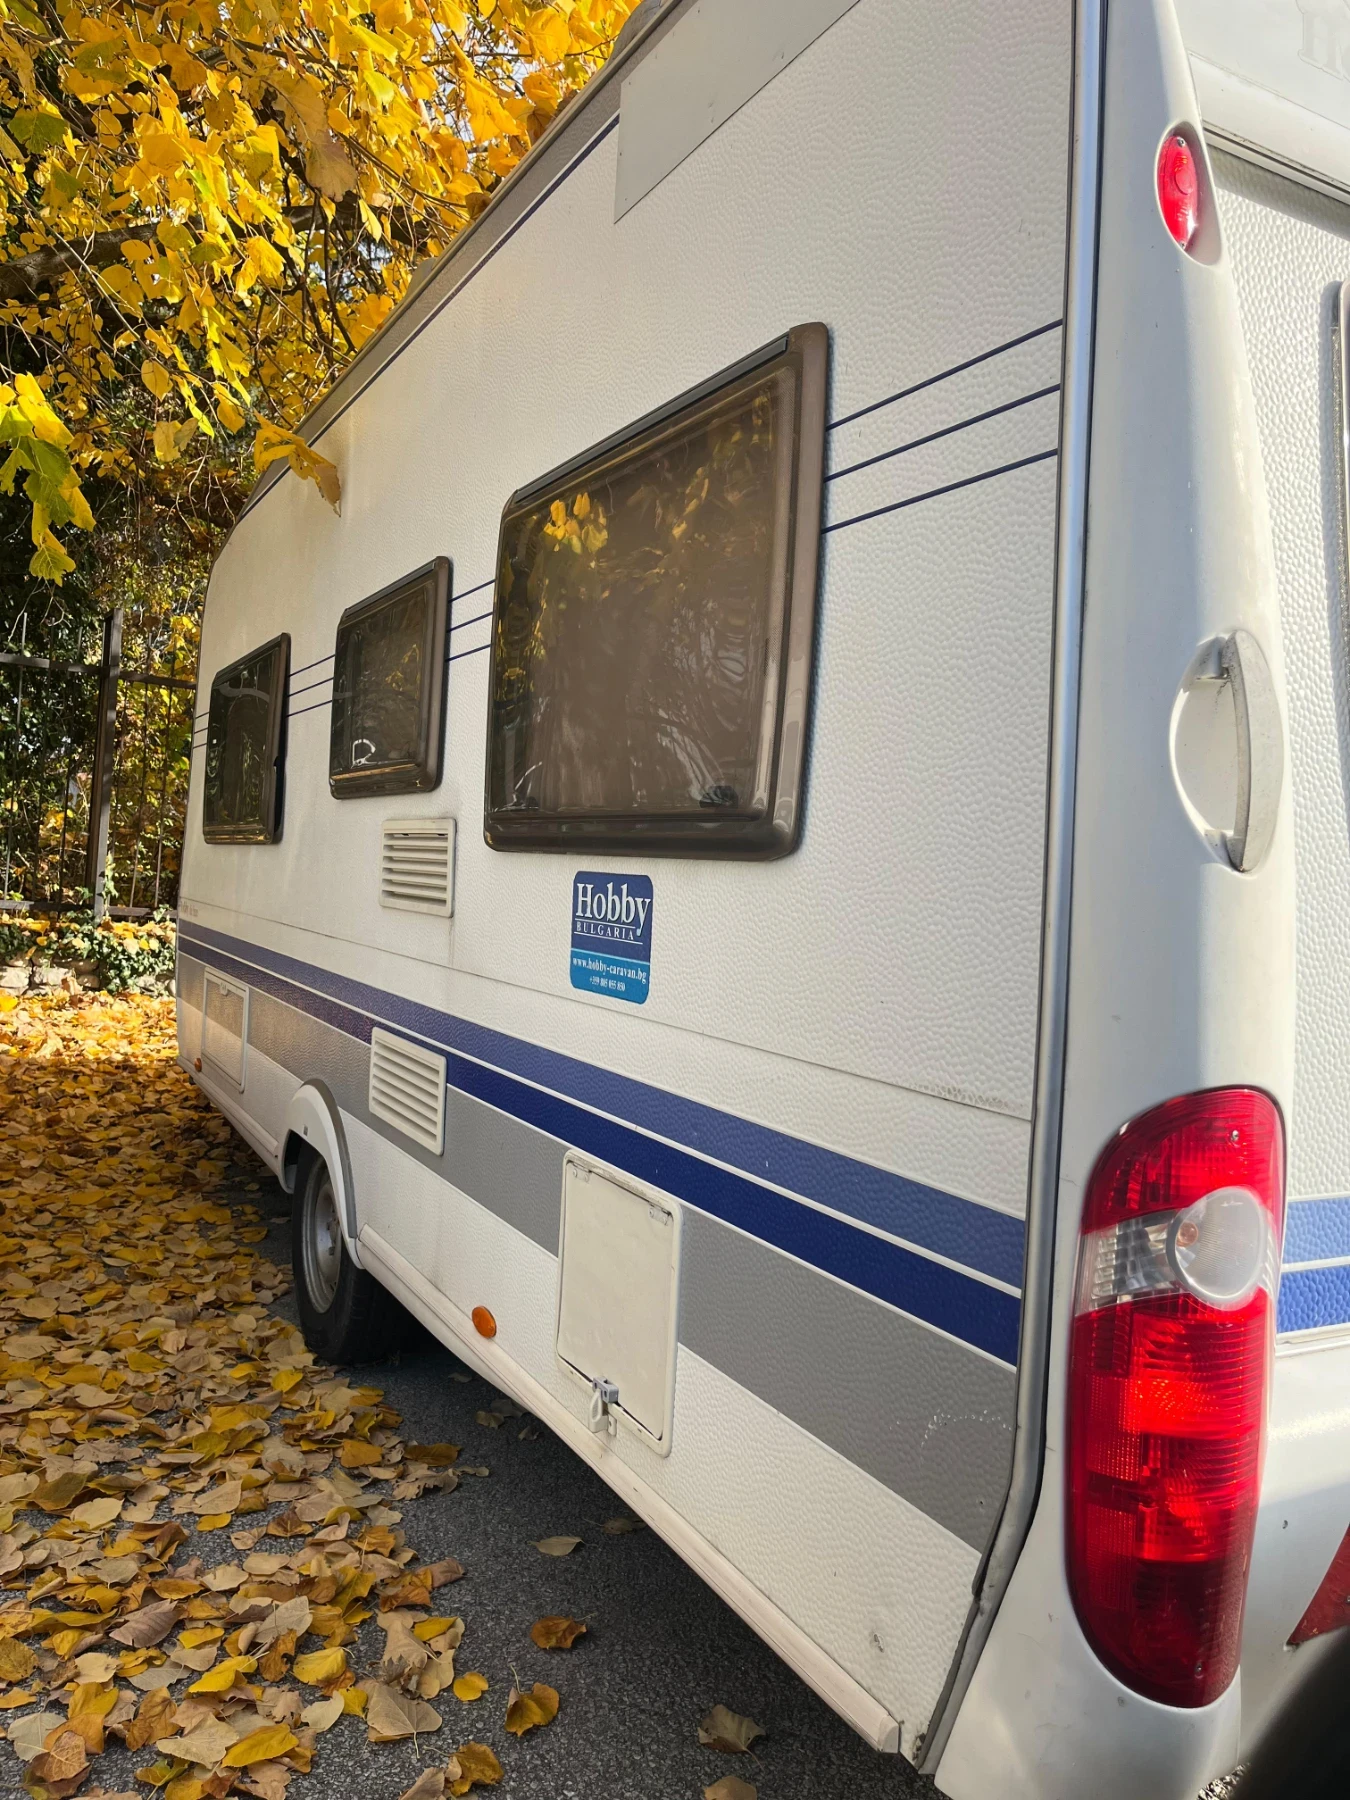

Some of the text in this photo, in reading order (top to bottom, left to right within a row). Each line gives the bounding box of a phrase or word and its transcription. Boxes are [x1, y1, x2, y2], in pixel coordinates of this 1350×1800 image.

[575, 881, 651, 937] Hobby
[576, 922, 634, 940] BULGARIA
[572, 957, 647, 984] www.hobby-caravan.bg
